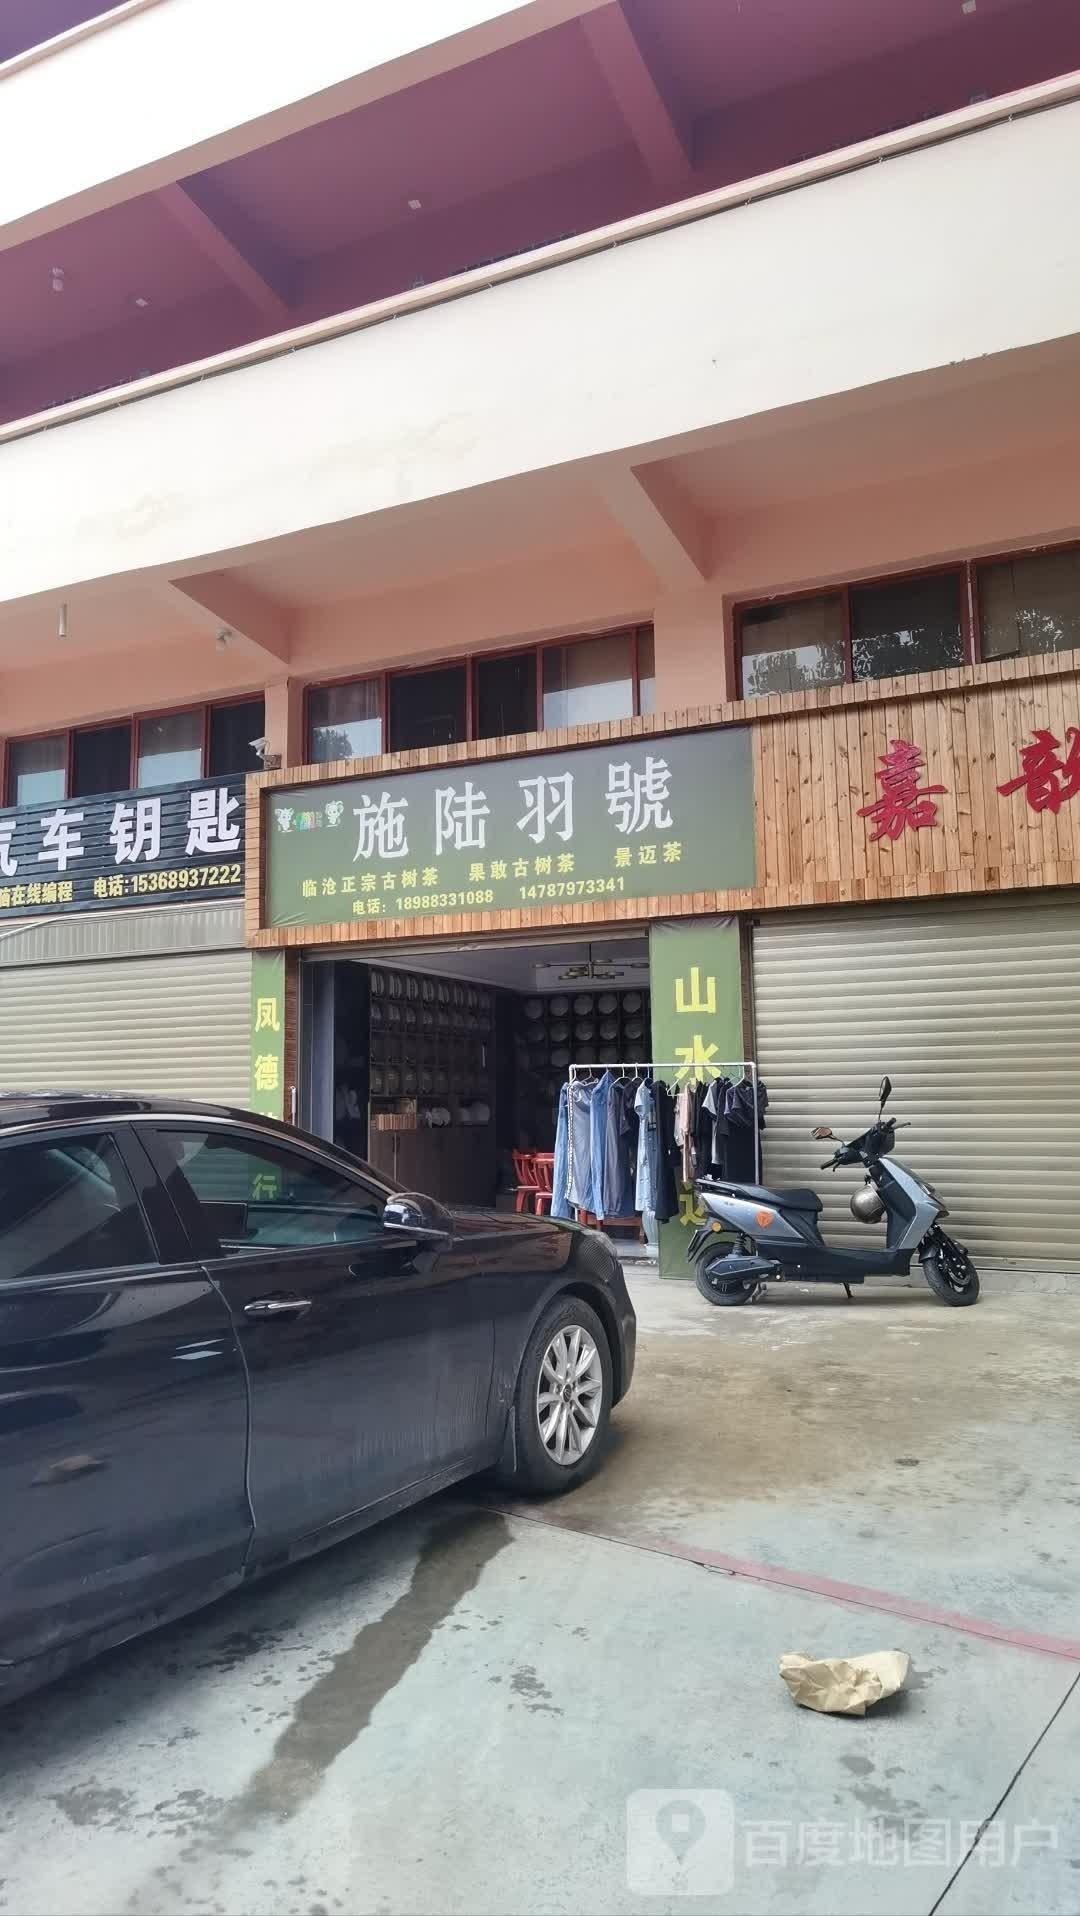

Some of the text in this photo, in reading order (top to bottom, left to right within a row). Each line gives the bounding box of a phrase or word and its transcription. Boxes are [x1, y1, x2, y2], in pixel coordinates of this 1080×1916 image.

[353, 756, 674, 862] 施陆羽號
[302, 841, 682, 898] 临沧正宗古树茶 果敢古树茶 景迈茶
[519, 876, 625, 900] 14787973341
